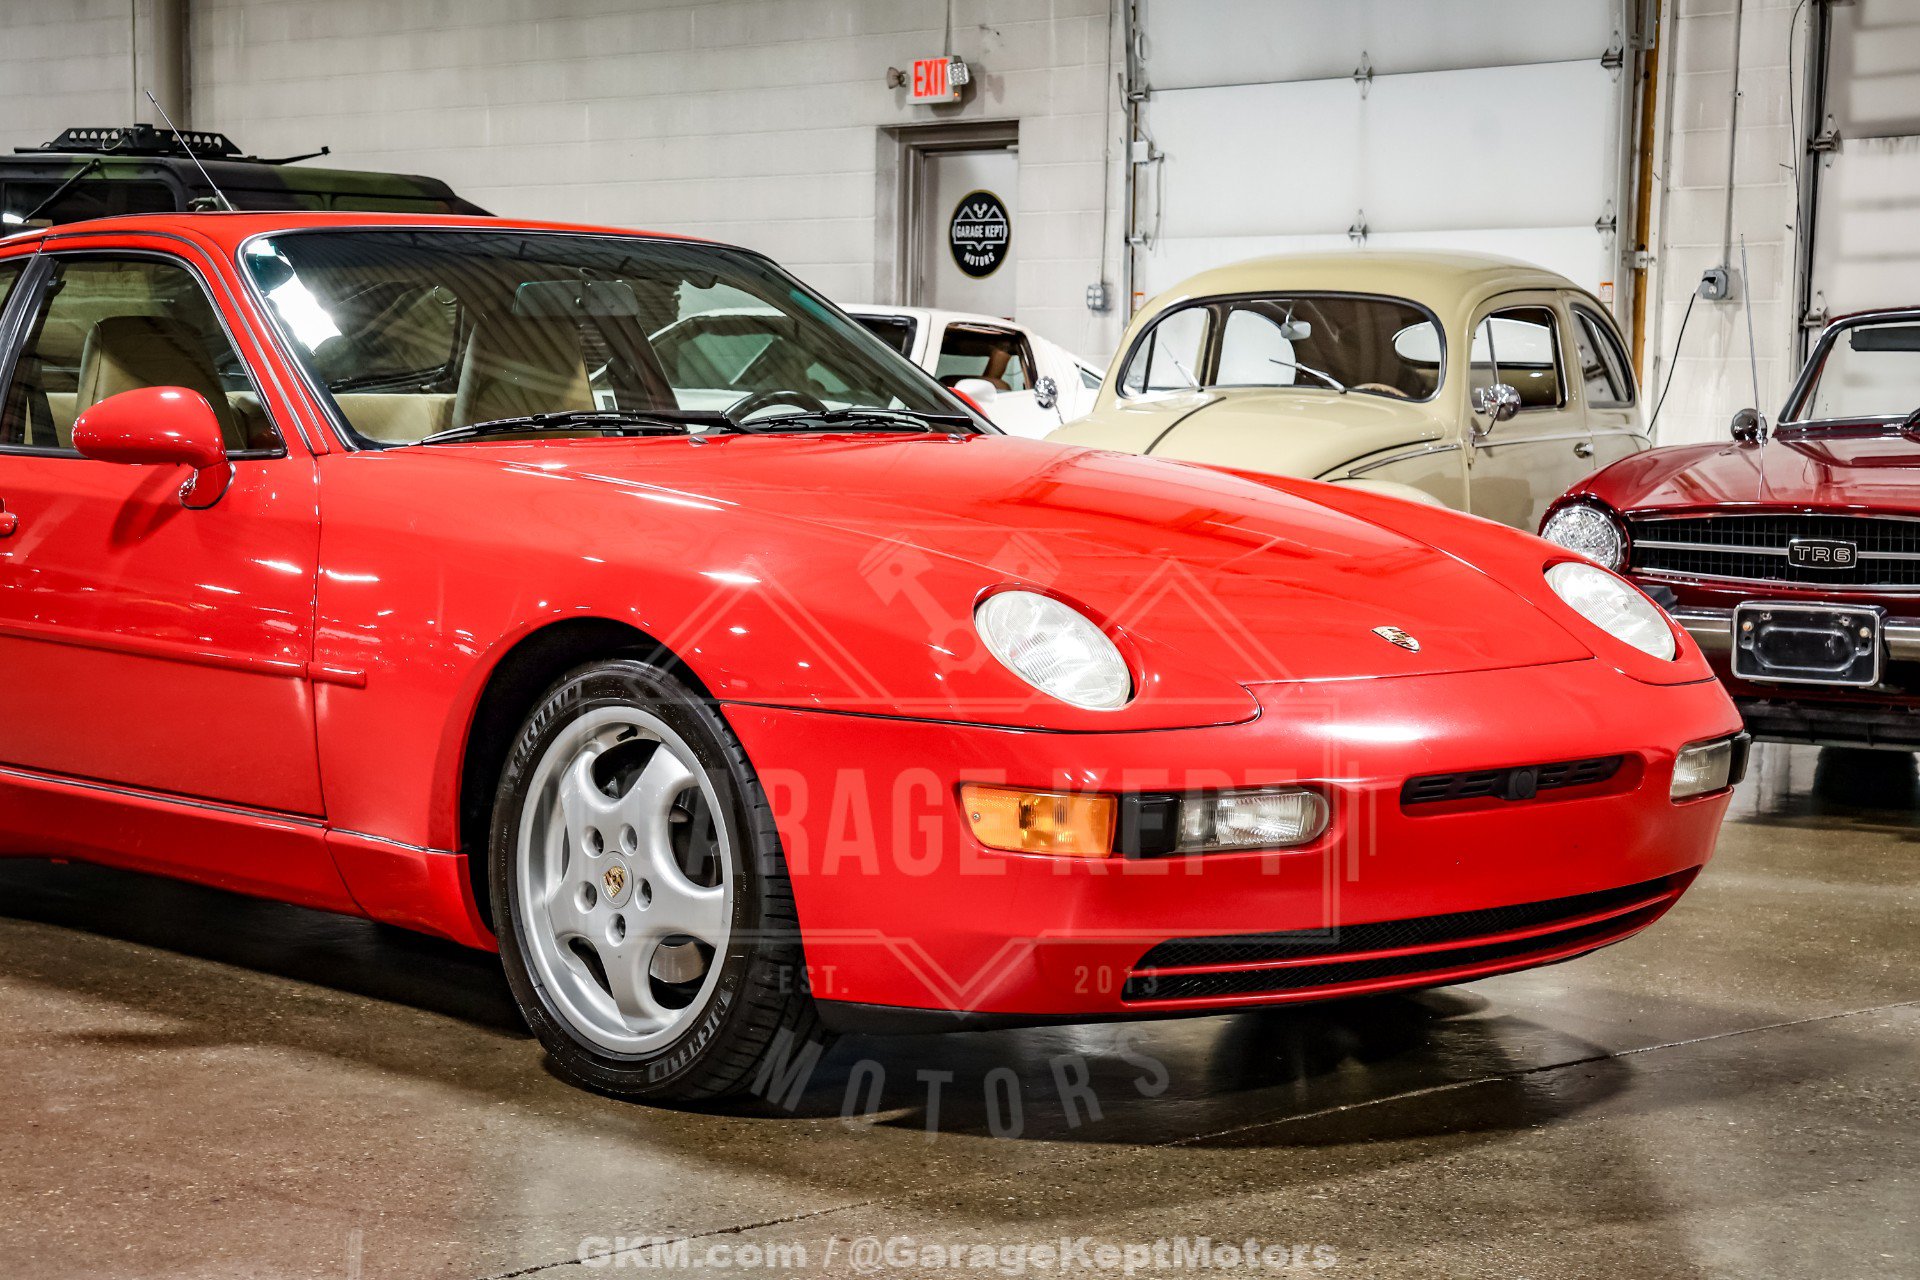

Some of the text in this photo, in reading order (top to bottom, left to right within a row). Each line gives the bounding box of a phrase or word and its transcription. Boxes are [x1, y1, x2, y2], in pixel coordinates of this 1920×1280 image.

[913, 58, 948, 97] EXIT
[956, 225, 1004, 238] GARAGE KEPT
[963, 252, 995, 267] MOTORS
[1793, 545, 1851, 563] TR6
[507, 681, 582, 778] MICHELIN
[648, 989, 734, 1083] MICHELIN
